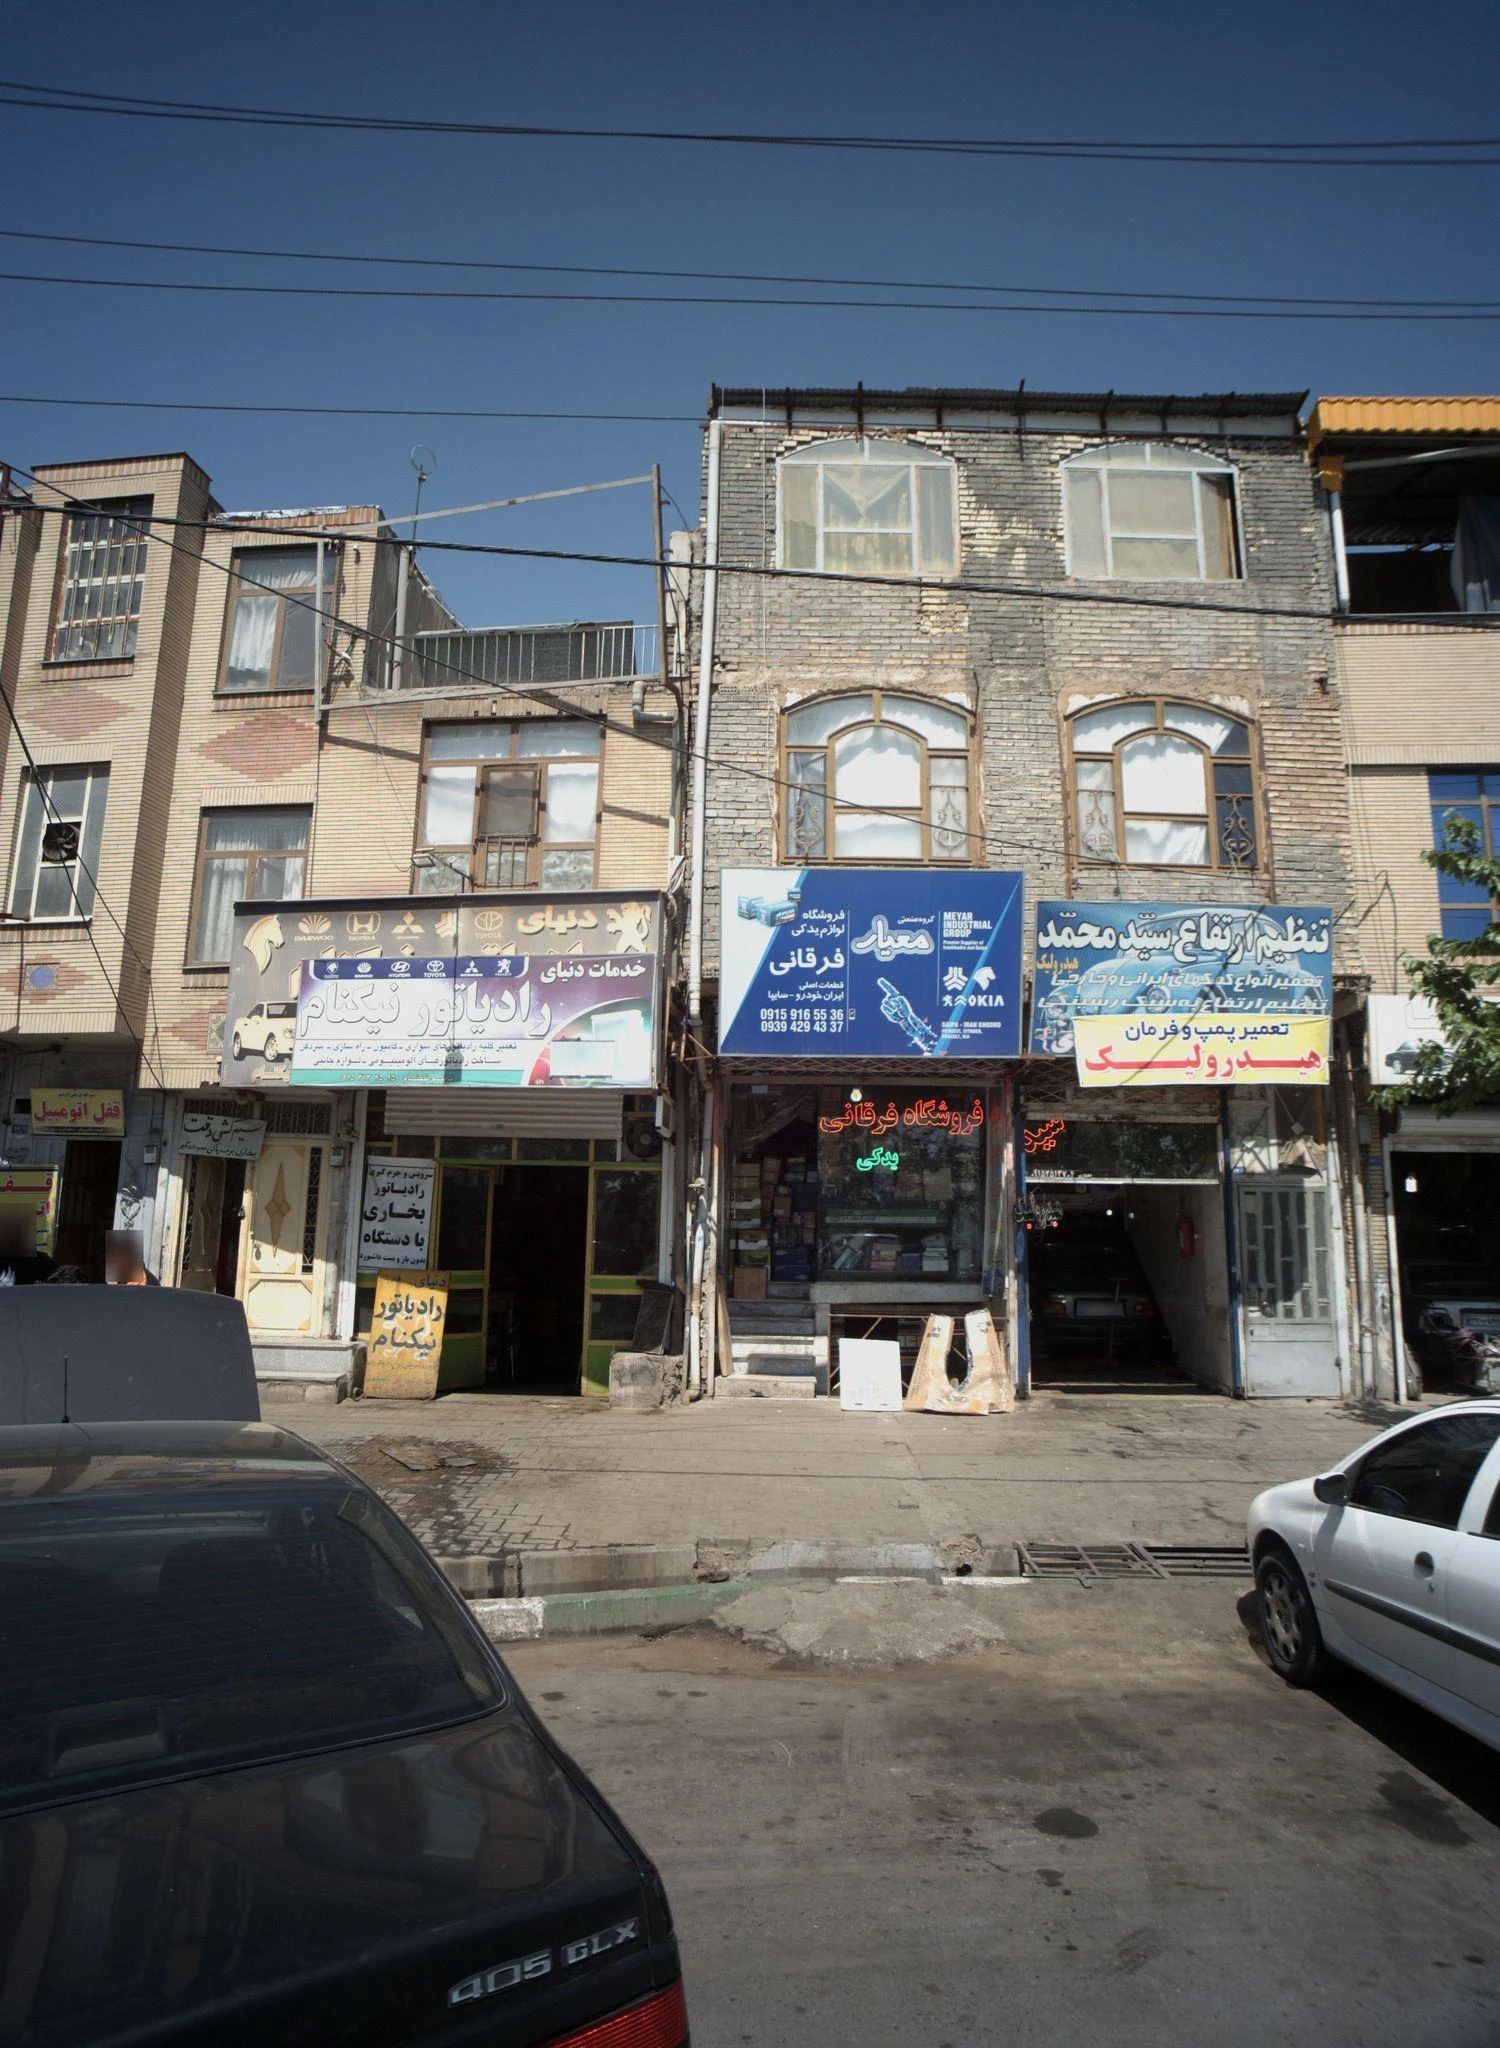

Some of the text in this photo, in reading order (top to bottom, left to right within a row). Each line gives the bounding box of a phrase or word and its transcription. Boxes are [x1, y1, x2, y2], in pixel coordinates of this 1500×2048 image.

[517, 905, 598, 935] دنیای
[803, 909, 845, 922] فروشگاه
[898, 915, 935, 924] گروه صنعتی
[943, 912, 973, 921] MEYAR
[791, 924, 845, 938] لوازم یدکی
[943, 921, 993, 929] INDUSTRIAL
[943, 929, 972, 938] GROUP
[853, 917, 932, 959] معیار
[1173, 912, 1255, 963] ارتفاع
[1255, 914, 1330, 965] تنظیم
[769, 947, 845, 975] فرقانی
[1036, 953, 1079, 975] هیدرولیک
[540, 959, 647, 983] خدمات دنیای
[1051, 973, 1107, 986] خارجی
[1108, 975, 1117, 985] و
[1119, 973, 1168, 987] ایرانی
[799, 982, 818, 990] اصلی
[1234, 973, 1273, 992] انواع
[1274, 974, 1324, 989] تعمیر
[768, 991, 789, 1001] سایپا
[795, 991, 822, 1001] خودرو
[823, 991, 844, 1001] ایران
[1178, 997, 1204, 1010] به
[1202, 997, 1262, 1013] ارتفاع
[1261, 997, 1329, 1012] تنظیم
[300, 981, 553, 1037] رادیاتور نیکنام
[760, 1009, 844, 1020] 0915 916 55 36
[760, 1021, 844, 1032] 0939 429 43 37
[1125, 1020, 1290, 1043] تعمیر پمپ و فرمان
[1085, 1043, 1322, 1078] هیدرولیک
[34, 1100, 121, 1123] قفل اتومبیل
[819, 1099, 984, 1135] فروشگاه فرقانی
[183, 1116, 214, 1138] دقت
[856, 1146, 899, 1172] یدکی
[0, 1172, 54, 1192] قف
[374, 1182, 425, 1199] رادیاتور
[363, 1201, 426, 1224] بخاری
[363, 1229, 424, 1251] با دستگاه
[414, 1275, 446, 1289] دنیای
[374, 1293, 443, 1321] رادیاتور
[373, 1327, 437, 1357] نیکنام
[452, 1921, 637, 2003] 405 GLX
